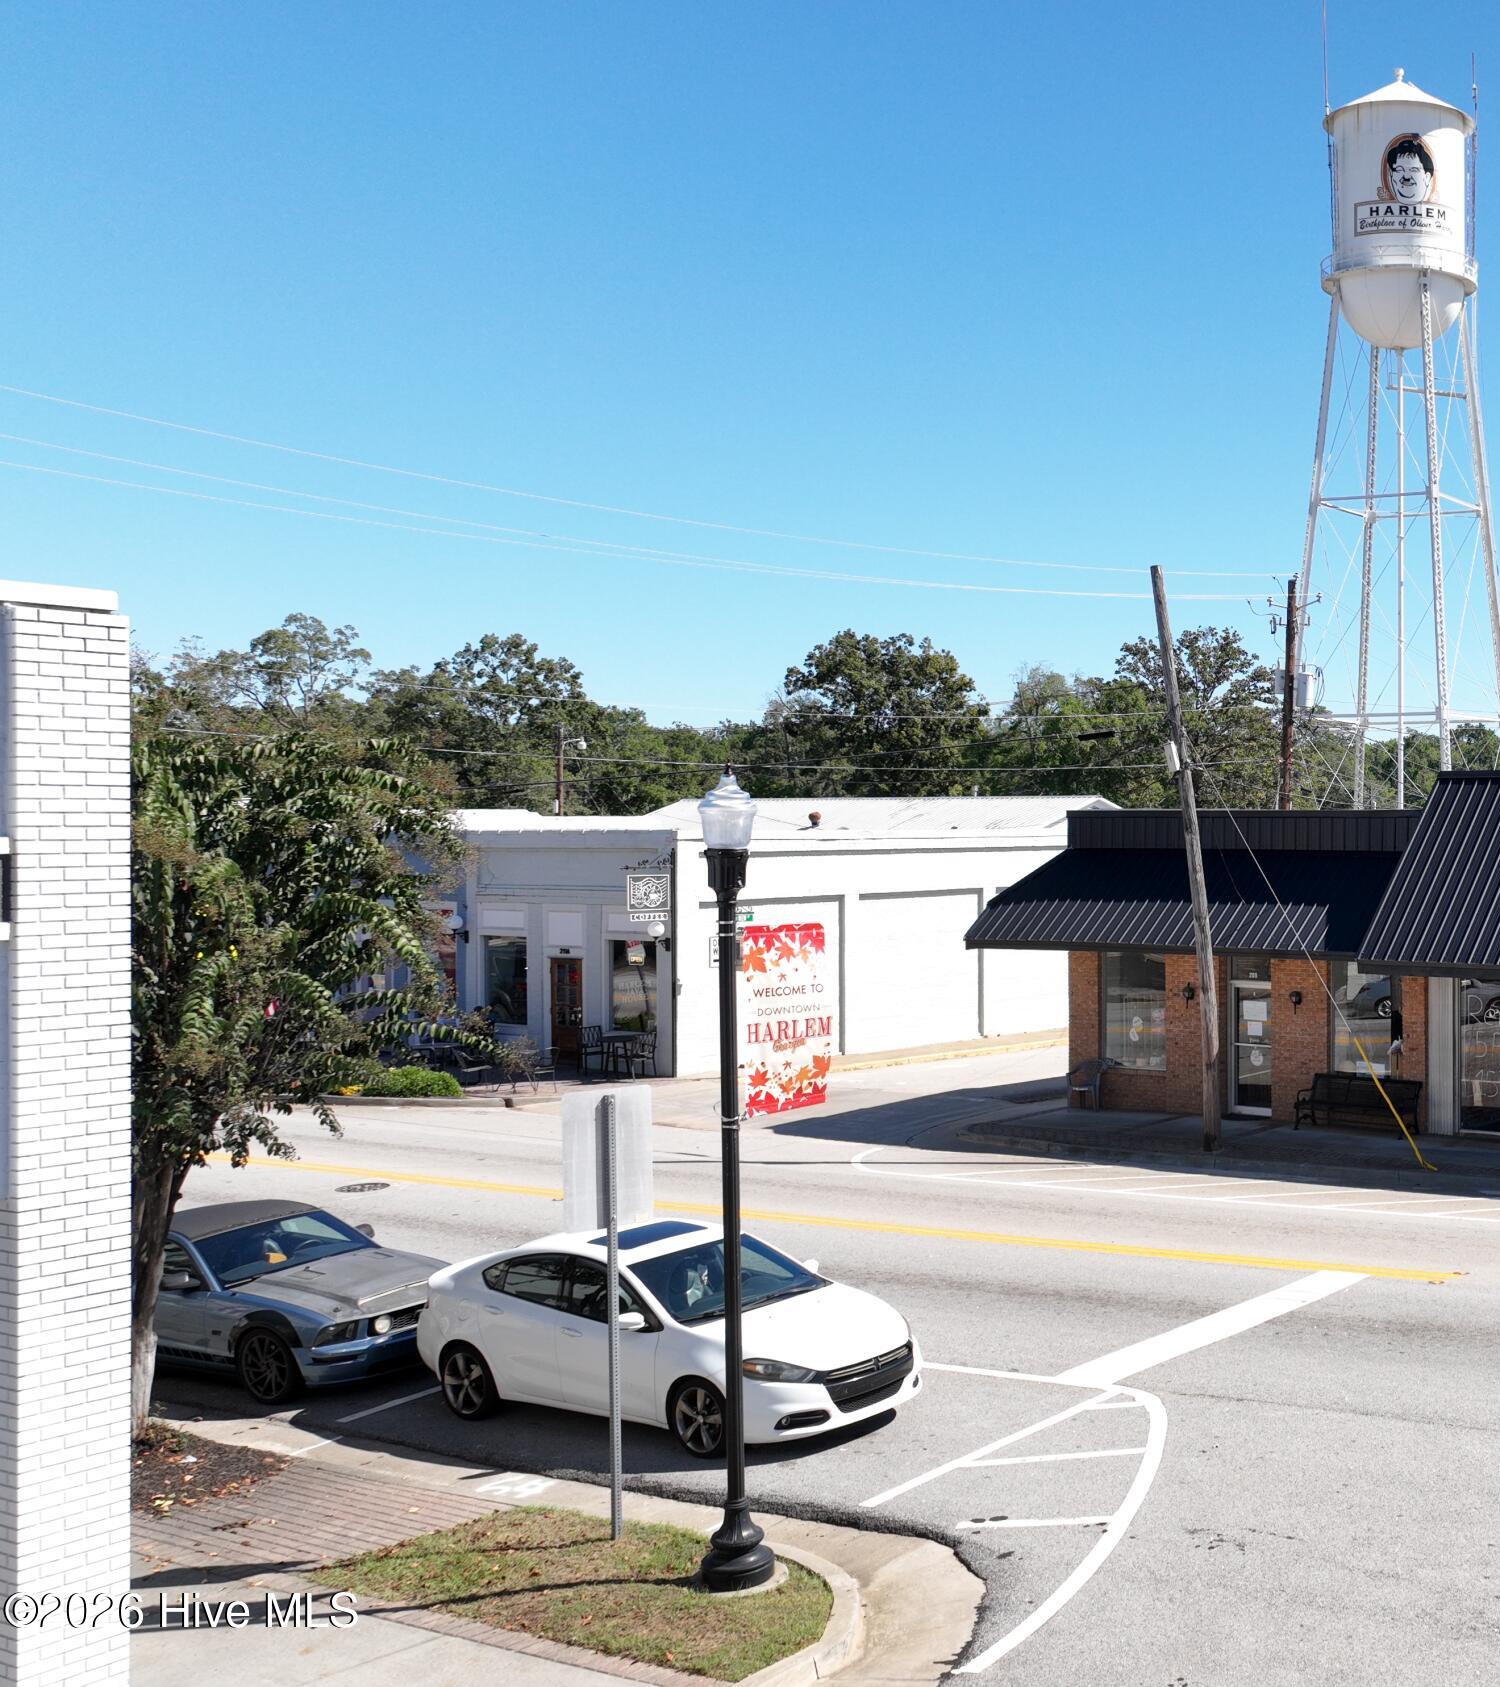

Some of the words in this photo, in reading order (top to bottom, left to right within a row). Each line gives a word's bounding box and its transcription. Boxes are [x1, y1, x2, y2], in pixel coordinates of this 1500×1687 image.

[1369, 205, 1446, 220] HARLEM
[1359, 219, 1396, 230] Birthplace
[1399, 218, 1408, 229] of
[753, 984, 807, 997] WELCOME
[810, 983, 824, 993] TO
[757, 1003, 821, 1016] DOWNTOWN
[747, 1016, 833, 1043] HARLEM
[773, 1038, 806, 1053] Georgia
